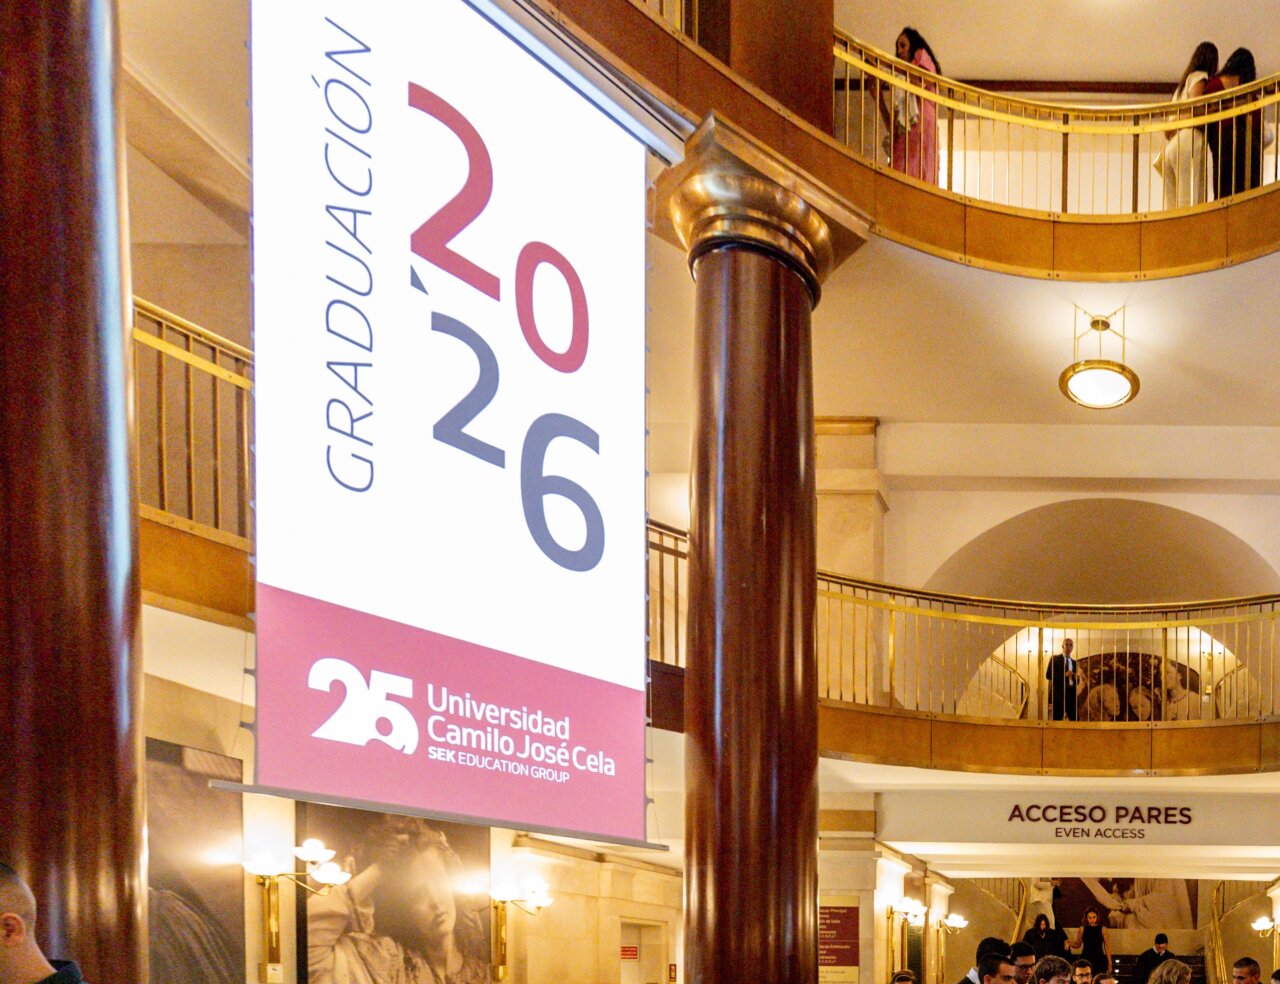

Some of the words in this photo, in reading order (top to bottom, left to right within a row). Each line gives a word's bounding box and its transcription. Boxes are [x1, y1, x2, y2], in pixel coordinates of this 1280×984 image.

[311, 16, 375, 493] GRADUACIÓN
[308, 657, 419, 755] 25
[427, 683, 570, 740] Universidad
[427, 715, 514, 756] Camilo
[516, 737, 570, 767] José
[572, 746, 616, 776] Cela
[427, 746, 456, 763] SEK
[458, 752, 530, 776] EDUCATION
[530, 766, 570, 783] GROUP
[1008, 804, 1106, 823] ACCESO
[1115, 806, 1192, 825] PARES
[1055, 827, 1090, 838] EVEN
[1094, 828, 1145, 839] ACCESS
